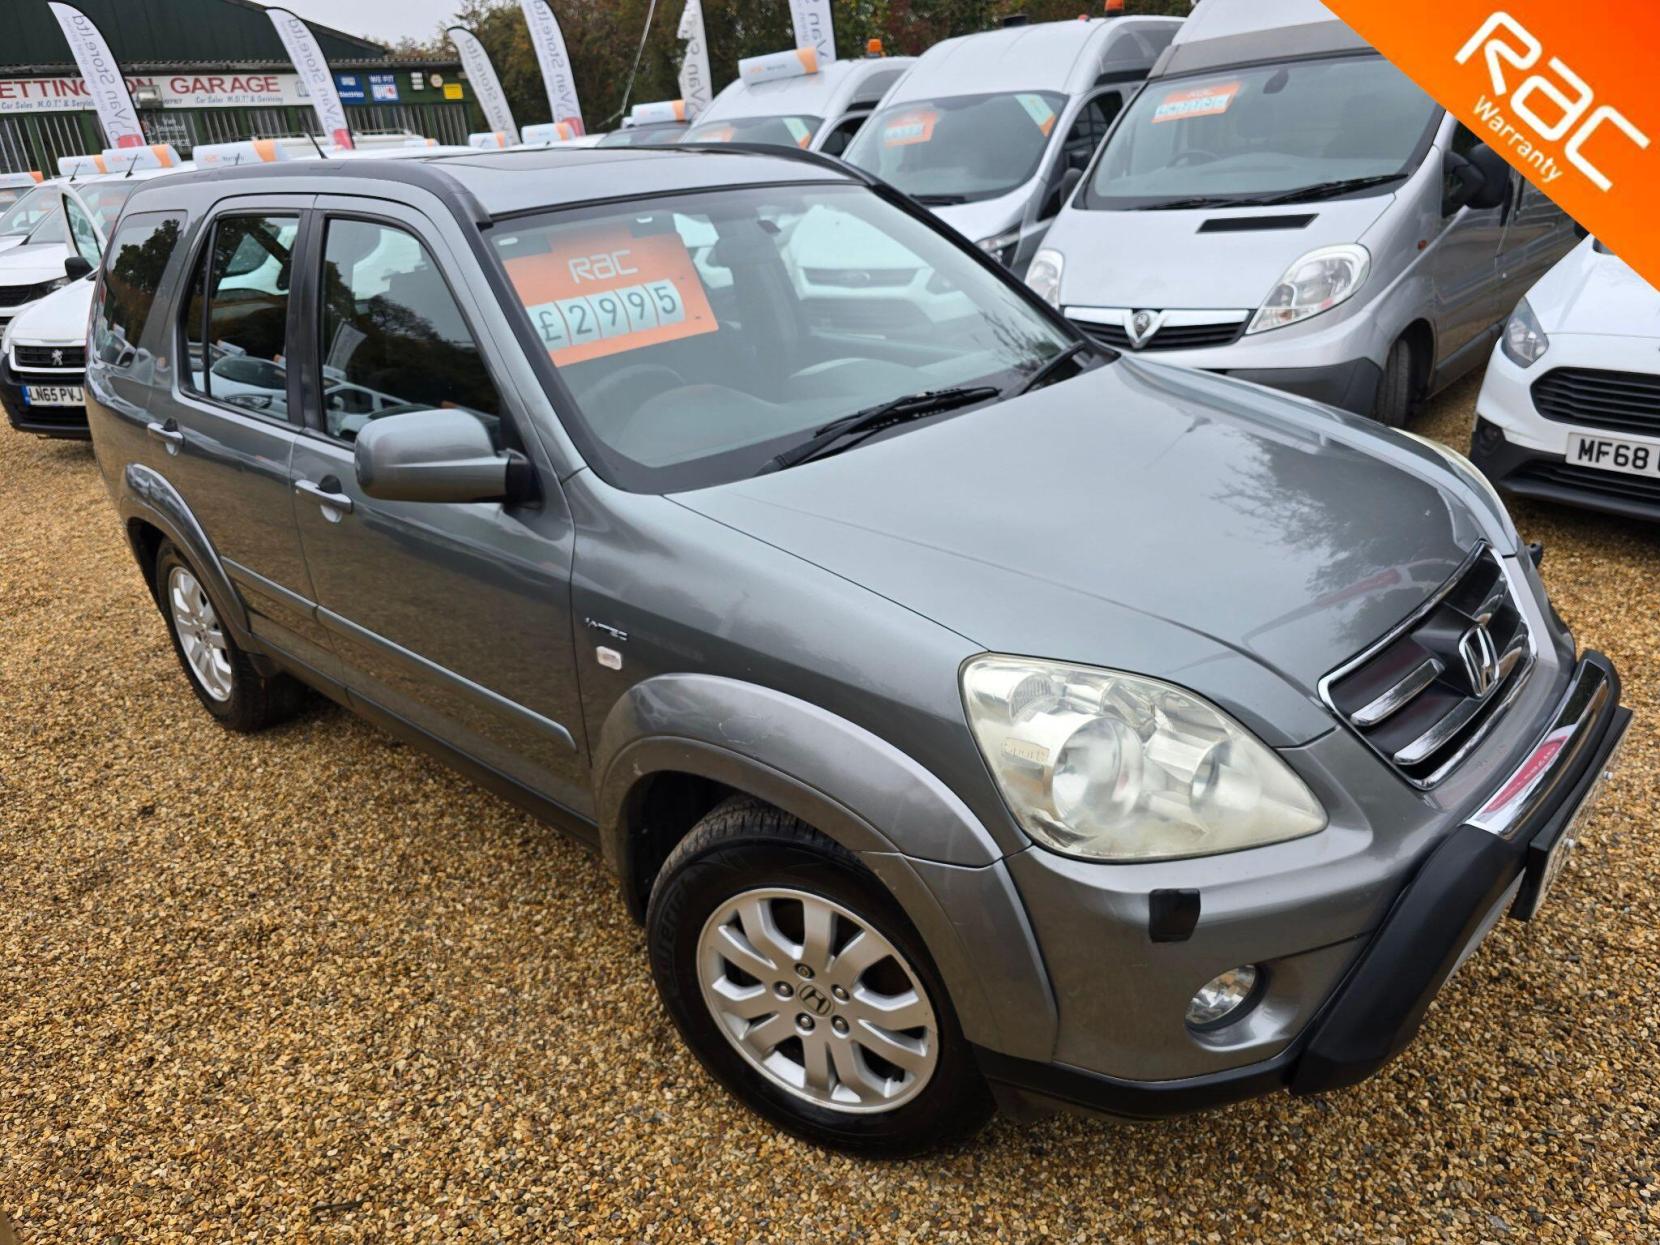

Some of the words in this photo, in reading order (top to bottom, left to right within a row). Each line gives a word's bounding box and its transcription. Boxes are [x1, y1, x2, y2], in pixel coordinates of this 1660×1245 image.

[170, 76, 281, 94] GARAGE
[538, 285, 677, 342] £2995
[29, 387, 59, 402] LN65
[60, 387, 84, 402] PVJ
[1577, 438, 1650, 471] MF68
